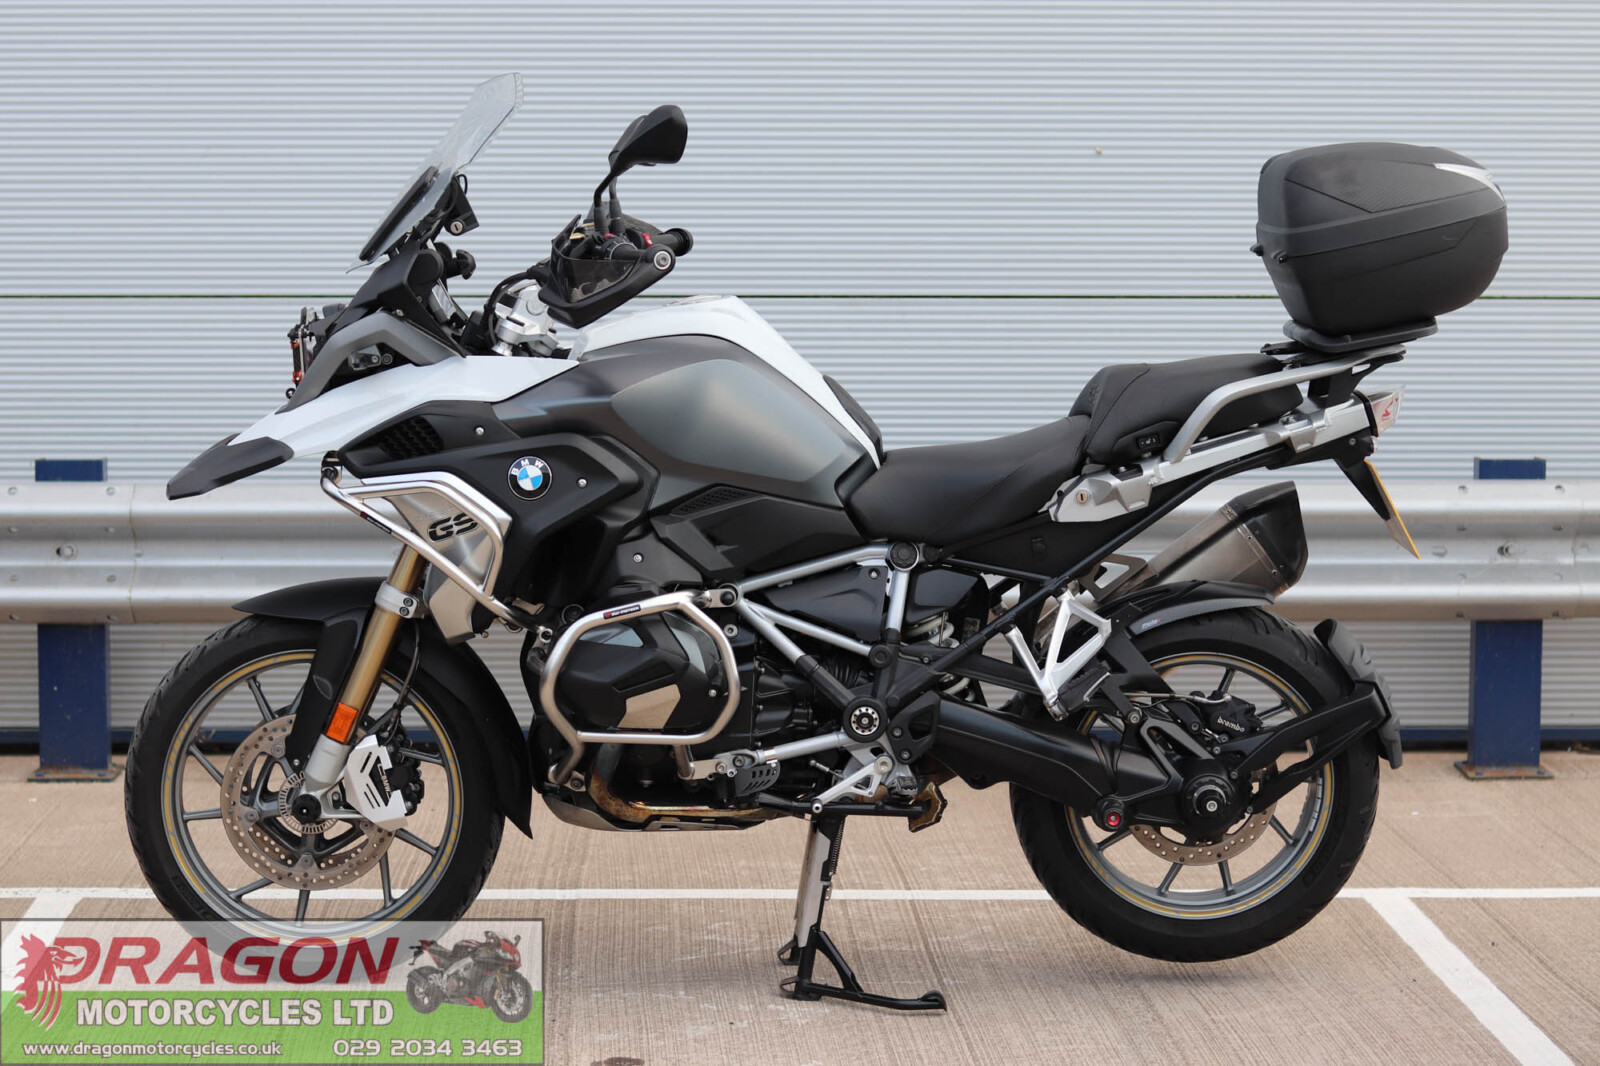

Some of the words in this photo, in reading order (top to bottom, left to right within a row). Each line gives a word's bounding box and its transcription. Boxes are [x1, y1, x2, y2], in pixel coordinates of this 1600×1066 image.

[511, 459, 544, 475] BMW
[428, 512, 478, 541] GS
[1217, 716, 1245, 732] brembo
